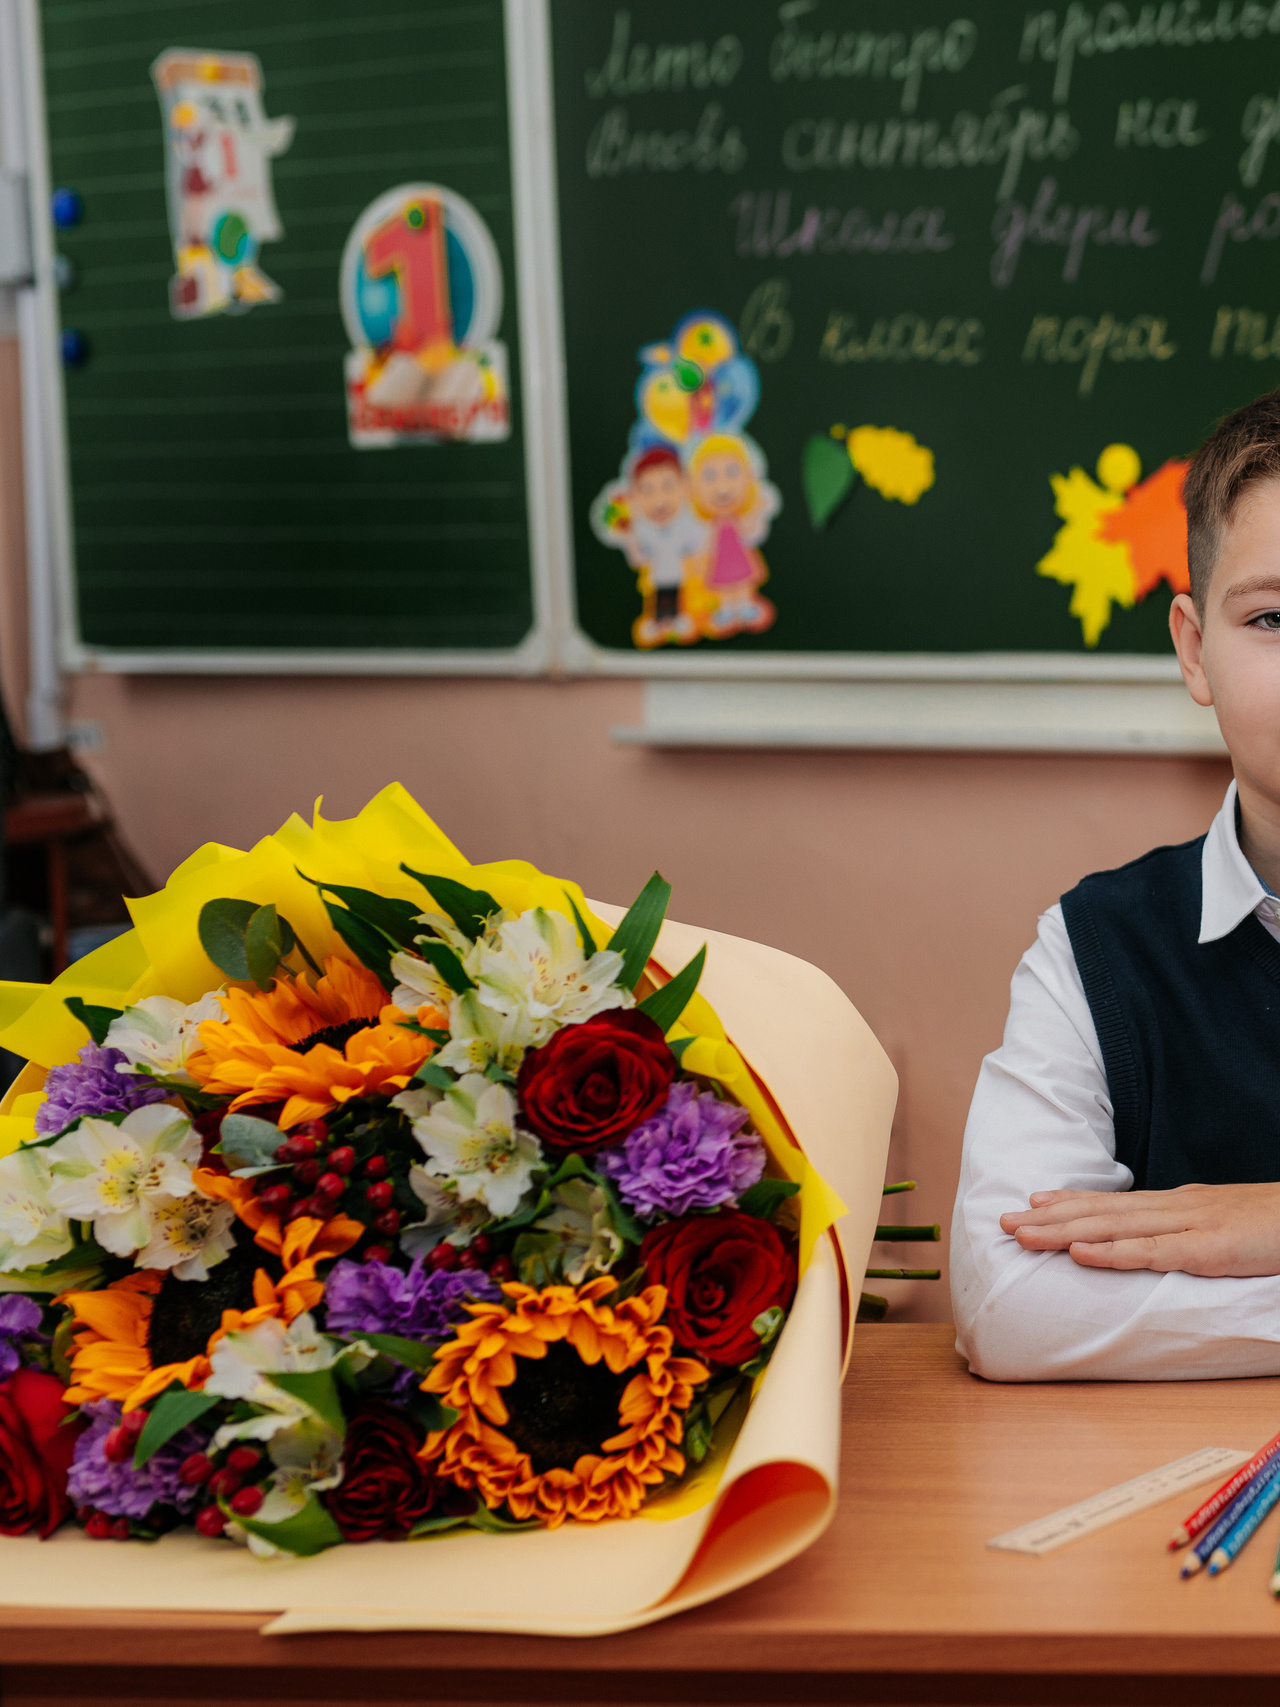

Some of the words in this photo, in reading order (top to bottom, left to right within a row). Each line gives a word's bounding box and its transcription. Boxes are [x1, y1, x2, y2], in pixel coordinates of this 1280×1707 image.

[585, 8, 744, 97] Лето
[770, 0, 978, 112] быстро
[585, 102, 748, 178] Вновь
[780, 84, 1081, 200] сентябрь
[1114, 97, 1206, 149] на
[727, 187, 957, 258] Школа
[988, 176, 1162, 290] двери
[737, 278, 796, 363] В
[818, 308, 986, 366] класс
[1021, 310, 1178, 397] пора
